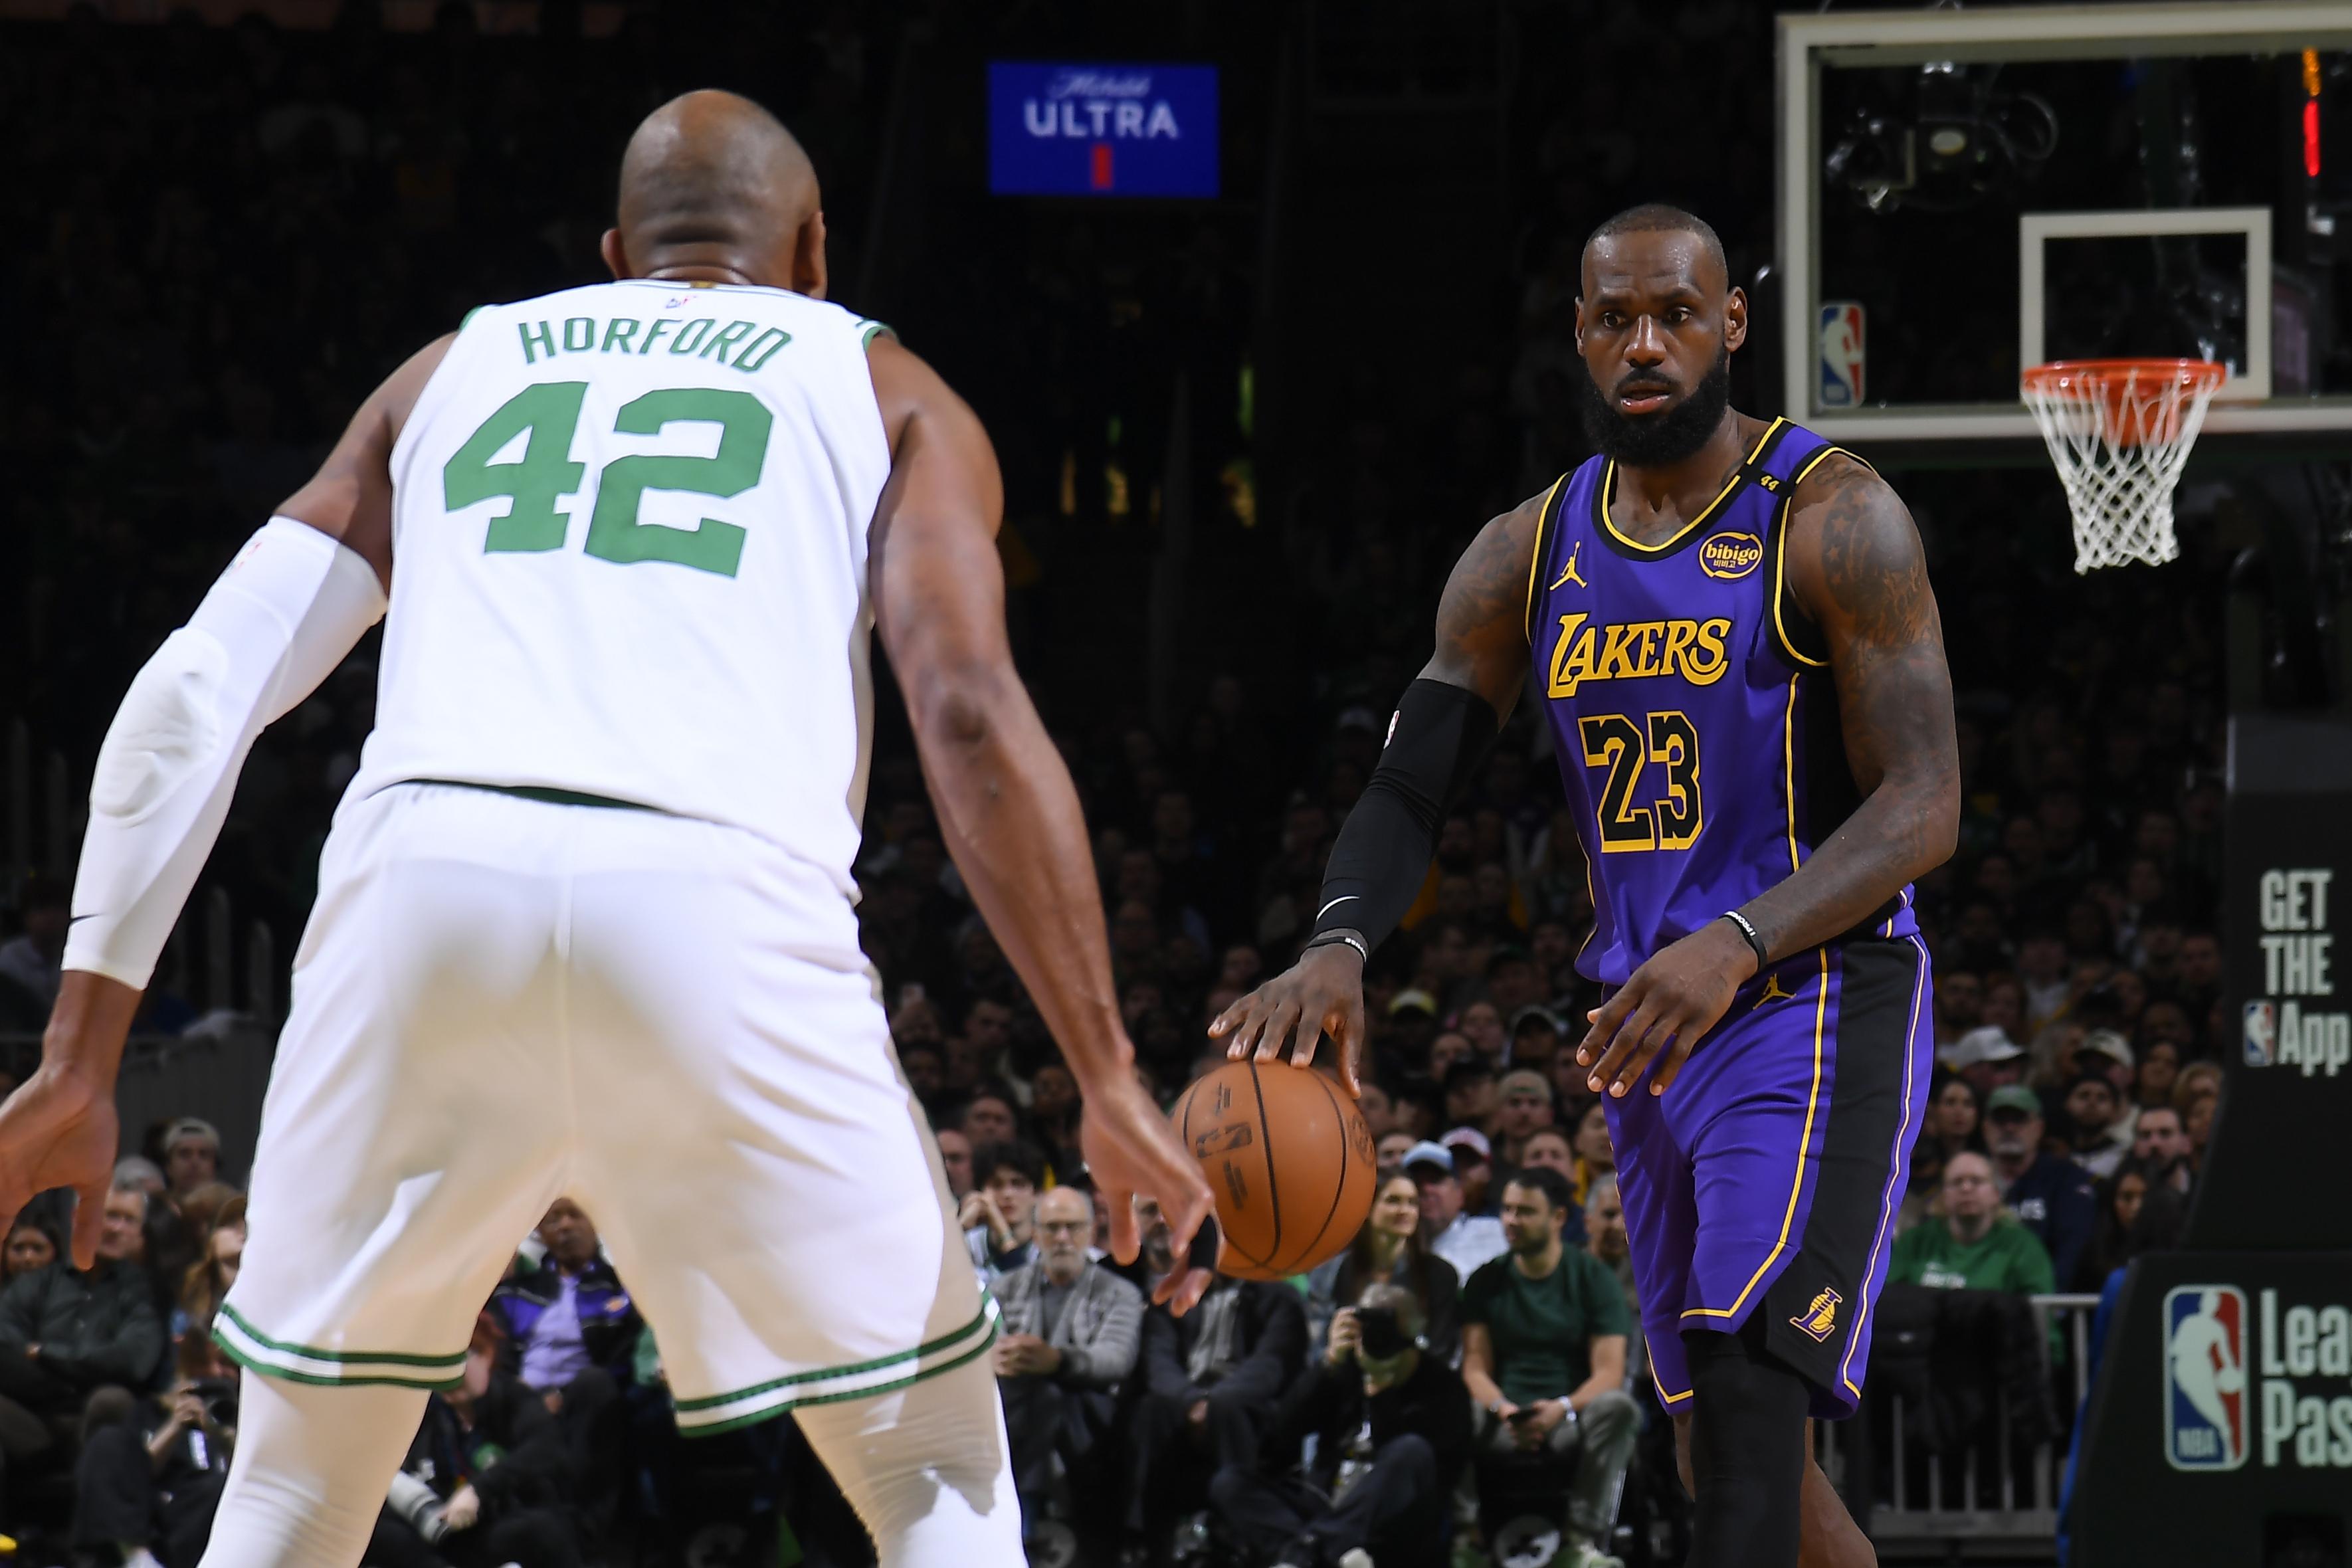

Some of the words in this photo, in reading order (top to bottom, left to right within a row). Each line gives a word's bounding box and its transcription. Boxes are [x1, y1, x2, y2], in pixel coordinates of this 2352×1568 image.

[1024, 98, 1179, 138] ULTRA
[518, 317, 792, 373] HORFORD
[444, 381, 773, 579] 42
[1761, 475, 1779, 491] 44
[1706, 543, 1759, 565] bibigo
[1548, 613, 1731, 699] LAKERS
[1578, 710, 1704, 853] 23
[2260, 869, 2333, 931] GET
[2260, 935, 2333, 995] THE
[2278, 999, 2350, 1077] App
[2260, 1288, 2352, 1377] Lea
